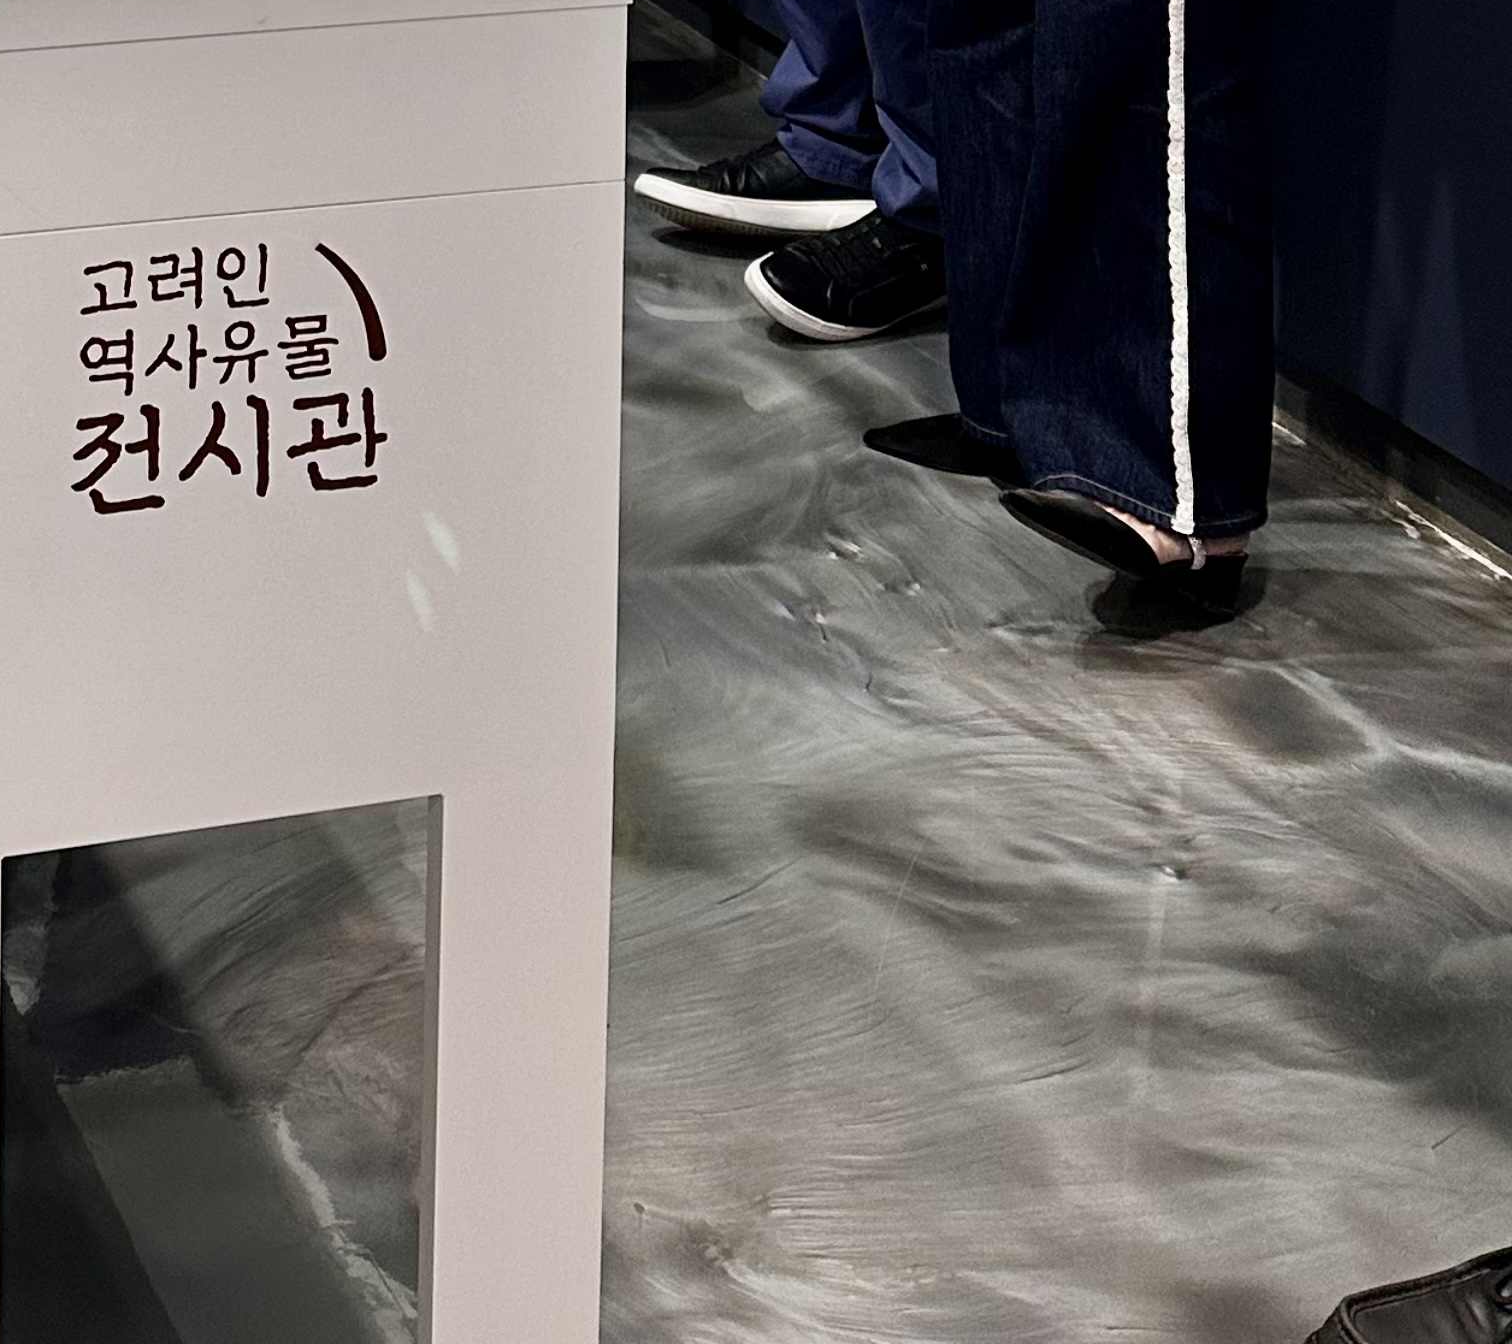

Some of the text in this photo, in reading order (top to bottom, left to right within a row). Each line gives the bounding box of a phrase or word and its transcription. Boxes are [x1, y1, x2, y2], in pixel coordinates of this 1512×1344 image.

[80, 242, 270, 315] 고려인
[79, 314, 339, 397] 역사유물
[71, 386, 388, 515] 전시관
